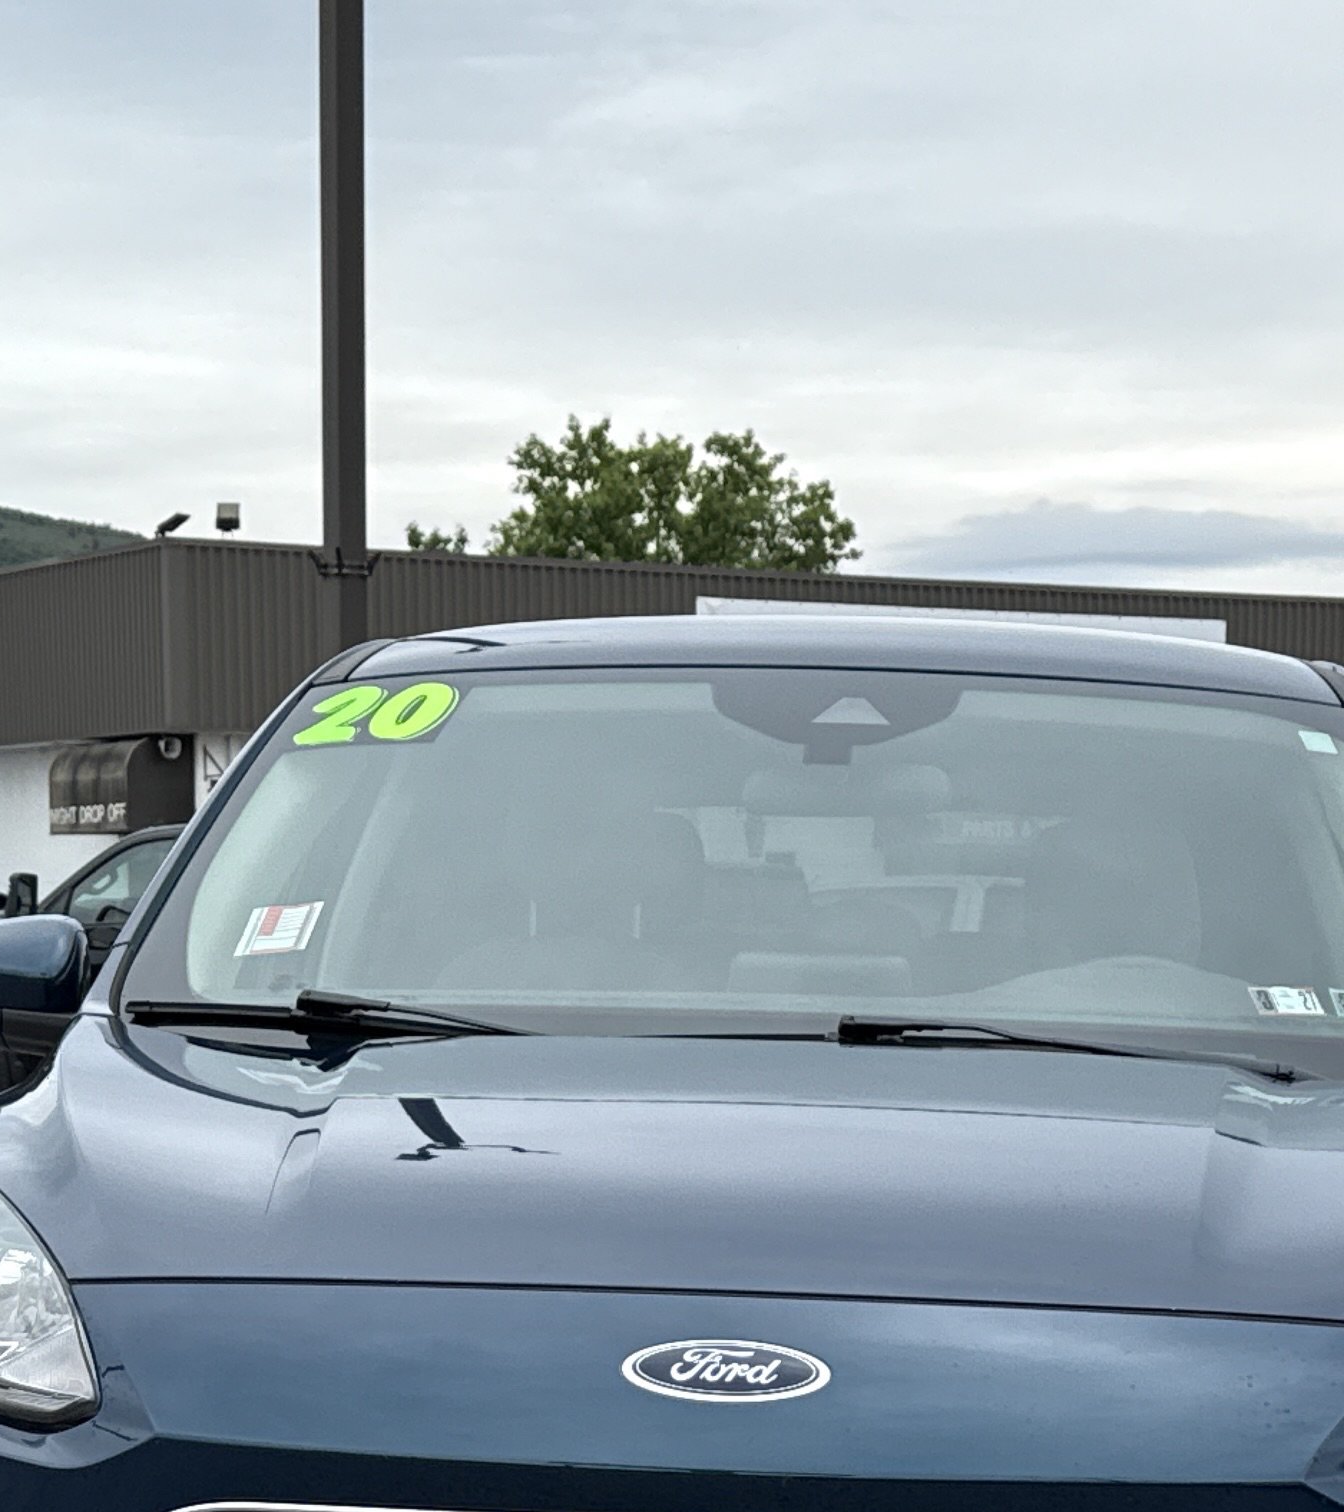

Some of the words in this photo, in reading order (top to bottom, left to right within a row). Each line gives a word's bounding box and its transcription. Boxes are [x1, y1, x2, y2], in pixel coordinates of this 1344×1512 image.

[293, 682, 460, 746] 20
[79, 803, 105, 824] DROP
[107, 802, 127, 822] OFF
[1257, 989, 1275, 1011] 3
[670, 1348, 783, 1385] Ford
